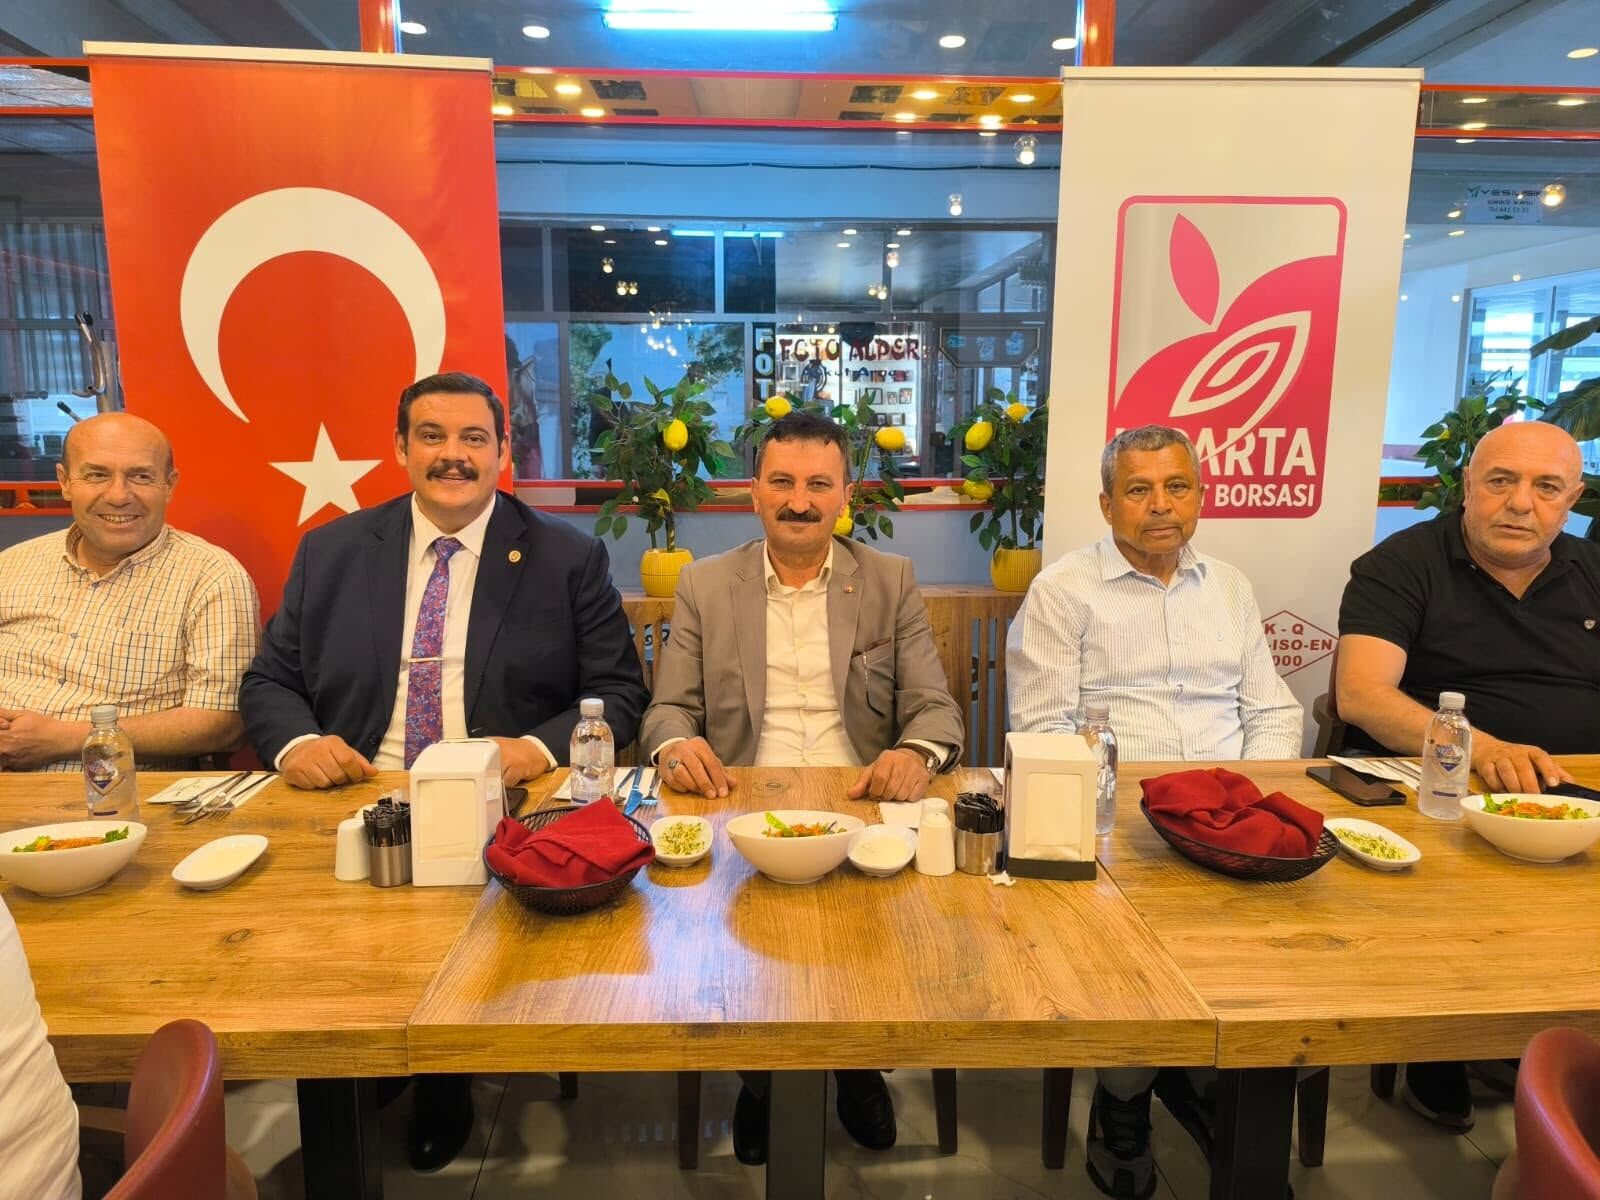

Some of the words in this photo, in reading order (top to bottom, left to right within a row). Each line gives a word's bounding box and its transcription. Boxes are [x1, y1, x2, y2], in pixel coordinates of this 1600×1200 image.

[779, 338, 840, 362] FOTO
[849, 338, 920, 362] ALPER
[754, 328, 774, 402] FOT
[1215, 483, 1315, 507] BORSASI
[1292, 623, 1304, 636] Q
[1272, 655, 1302, 667] 000
